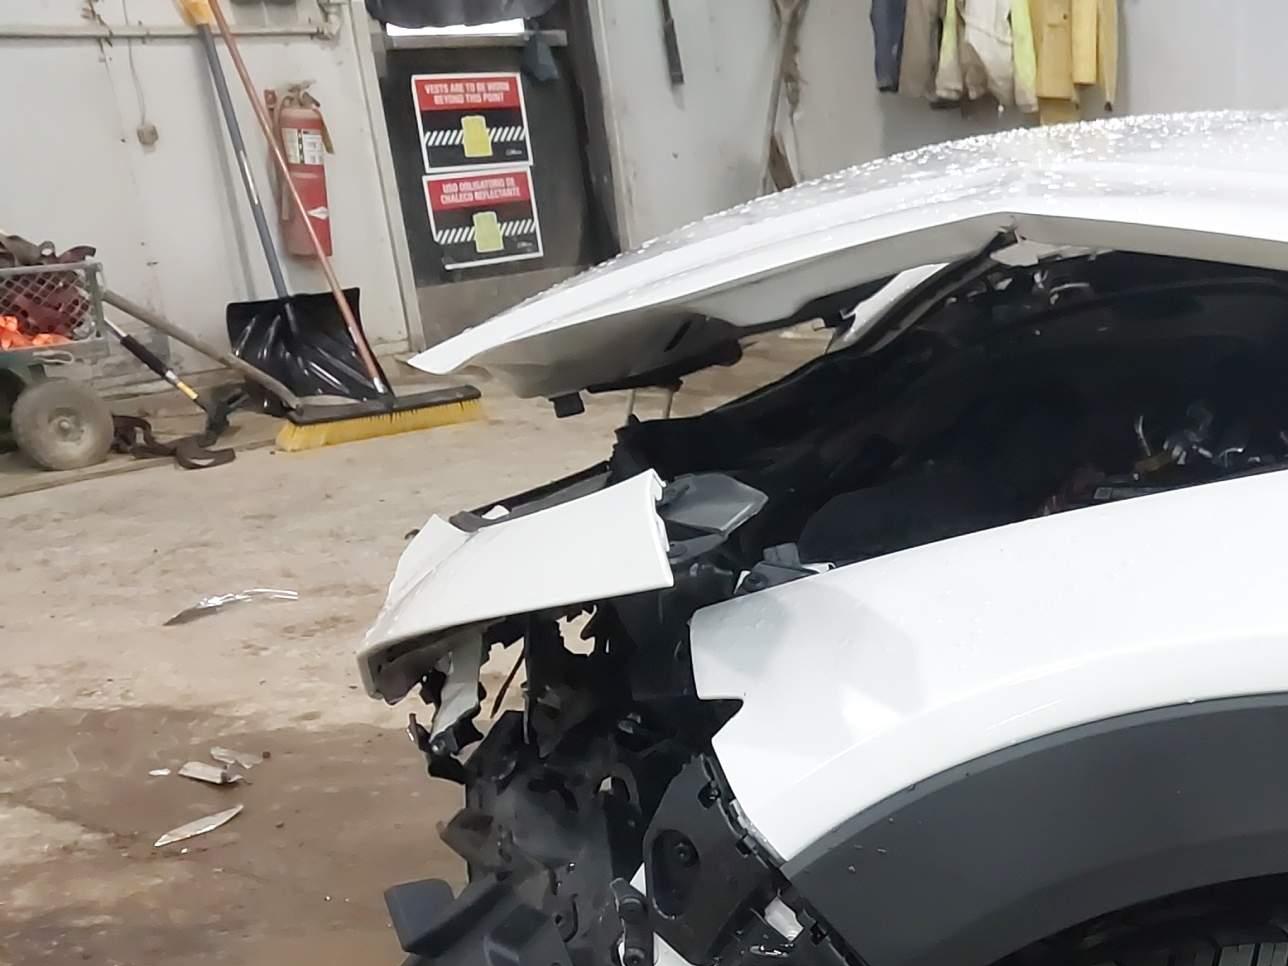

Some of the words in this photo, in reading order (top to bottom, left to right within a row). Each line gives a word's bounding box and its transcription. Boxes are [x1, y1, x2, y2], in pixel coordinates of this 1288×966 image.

[424, 83, 448, 94] VESTS
[450, 82, 464, 93] ARE
[465, 82, 475, 92] TO
[476, 82, 486, 92] BE
[434, 94, 464, 105] BEYOND
[465, 94, 482, 103] THIS
[483, 92, 504, 102] POINT
[442, 182, 458, 193] USO
[459, 178, 505, 192] OBLIGATORIO
[440, 192, 474, 205] CHALECO
